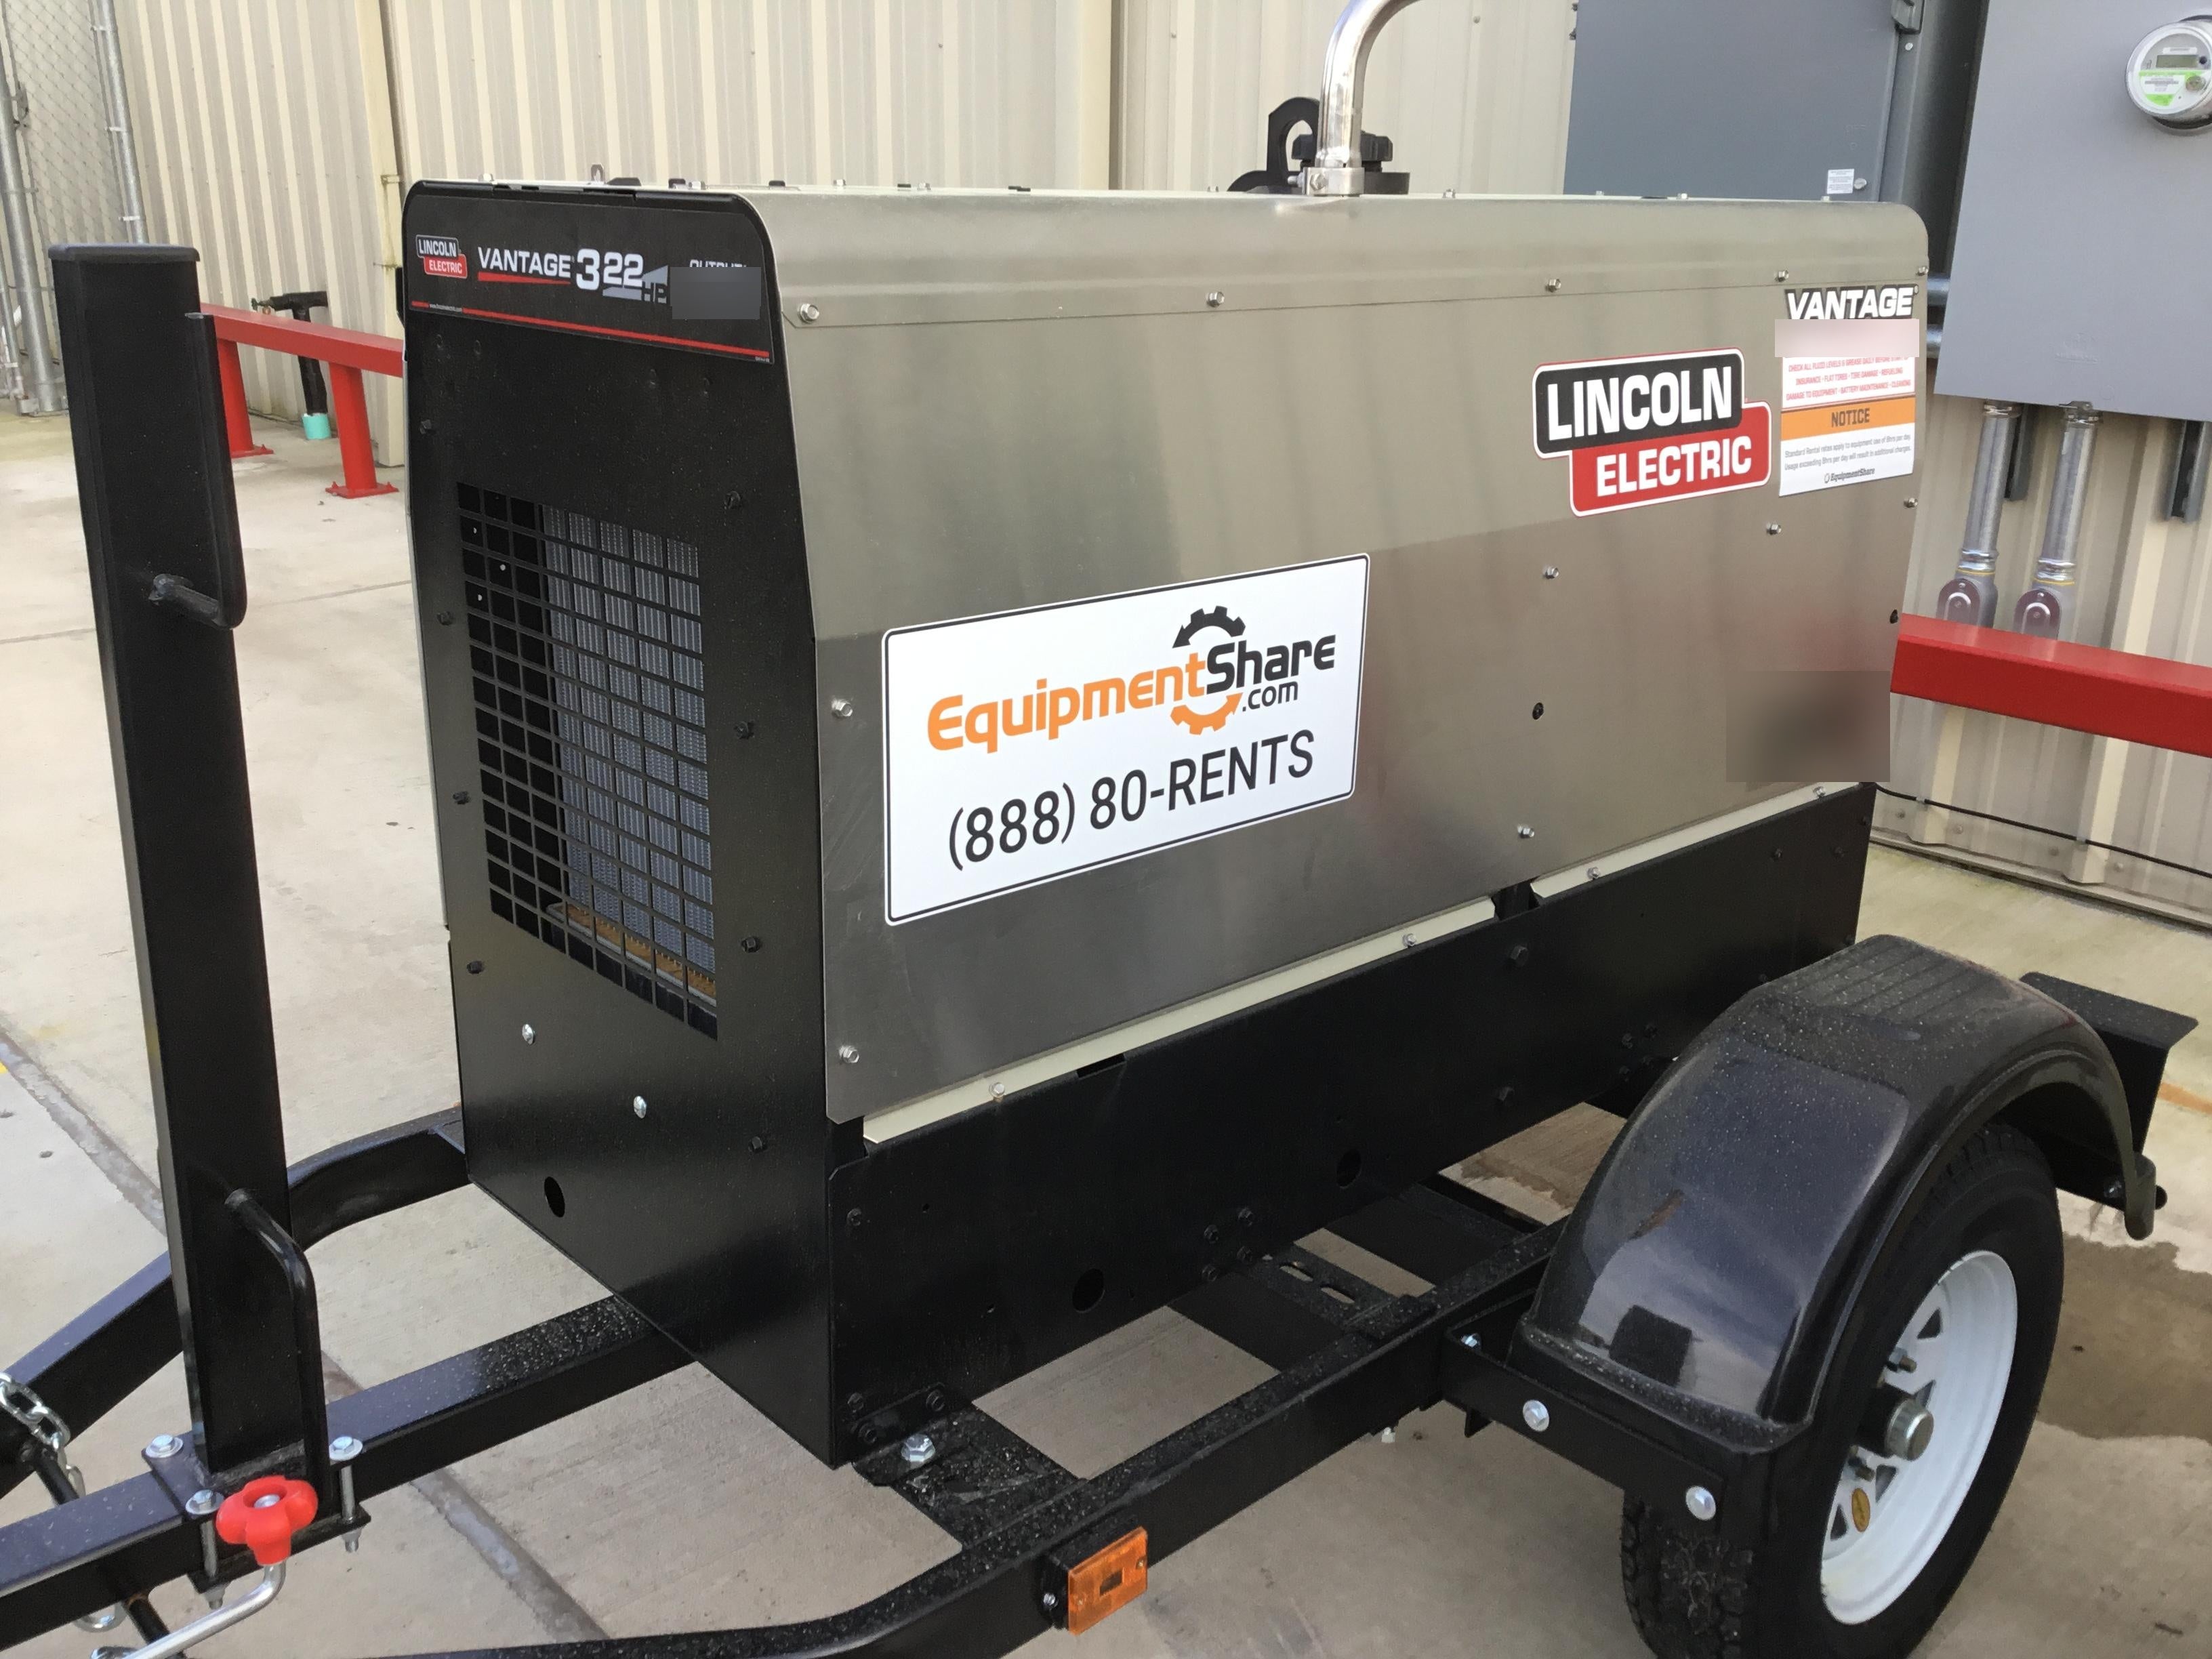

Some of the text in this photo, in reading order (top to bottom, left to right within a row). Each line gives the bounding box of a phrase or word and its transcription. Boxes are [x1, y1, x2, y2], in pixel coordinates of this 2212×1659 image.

[418, 239, 457, 257] LINCOLN
[428, 260, 462, 274] ELECTRIC
[478, 247, 571, 278] VANTAGE
[576, 248, 644, 290] 322
[1786, 287, 1914, 320] VANTAGE
[1547, 366, 1732, 441] LINCOLN
[1831, 408, 1870, 428] NOTICE
[1596, 436, 1753, 497] ELECTRIC
[1830, 468, 1875, 482] EquipmentShare
[927, 634, 1336, 754] EquipmentShare
[1242, 681, 1299, 713] .com
[949, 729, 1315, 872] (888) 80-RENTS
